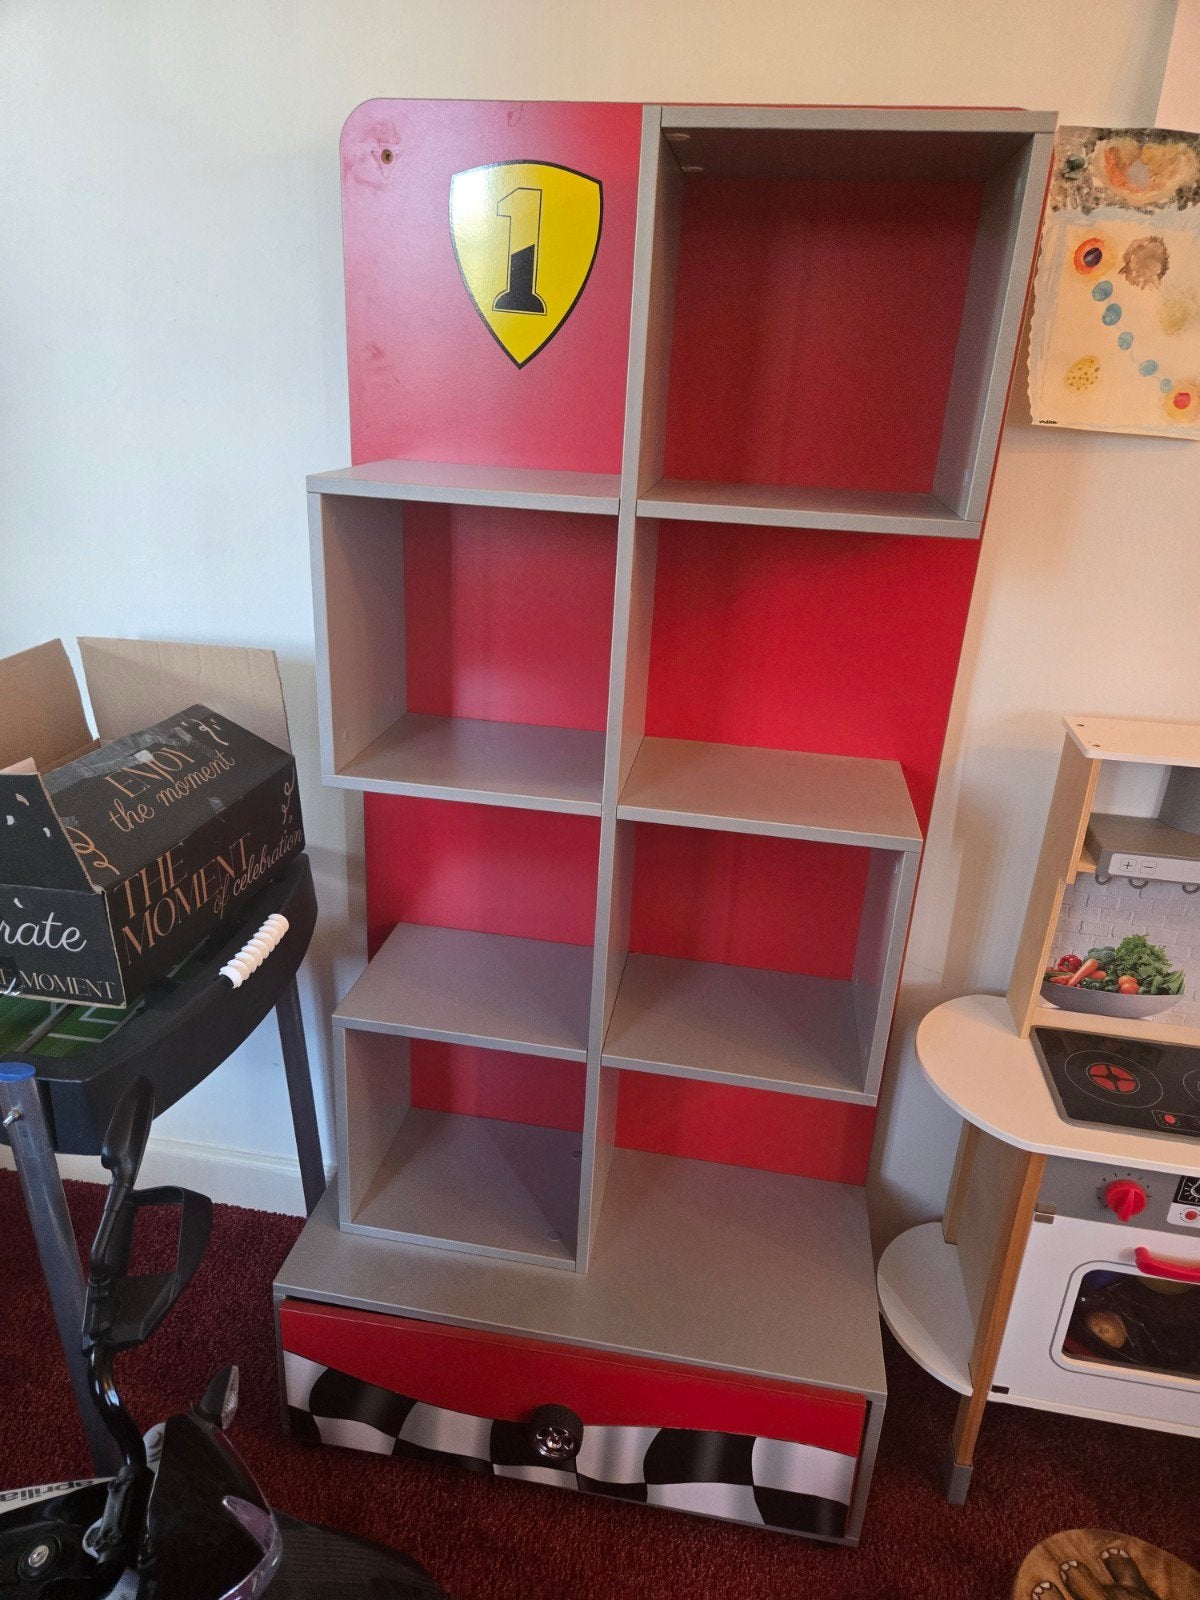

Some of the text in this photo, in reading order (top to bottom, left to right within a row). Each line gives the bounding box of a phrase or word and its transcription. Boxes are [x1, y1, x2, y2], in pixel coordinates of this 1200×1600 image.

[491, 187, 547, 316] 1
[104, 747, 195, 798] ENJOY
[109, 749, 236, 832] the moment
[113, 841, 188, 919] THE
[122, 832, 250, 966] MOMENT
[213, 829, 303, 920] of celebration
[19, 970, 115, 999] MOMENT
[0, 1480, 94, 1501] aprilia
